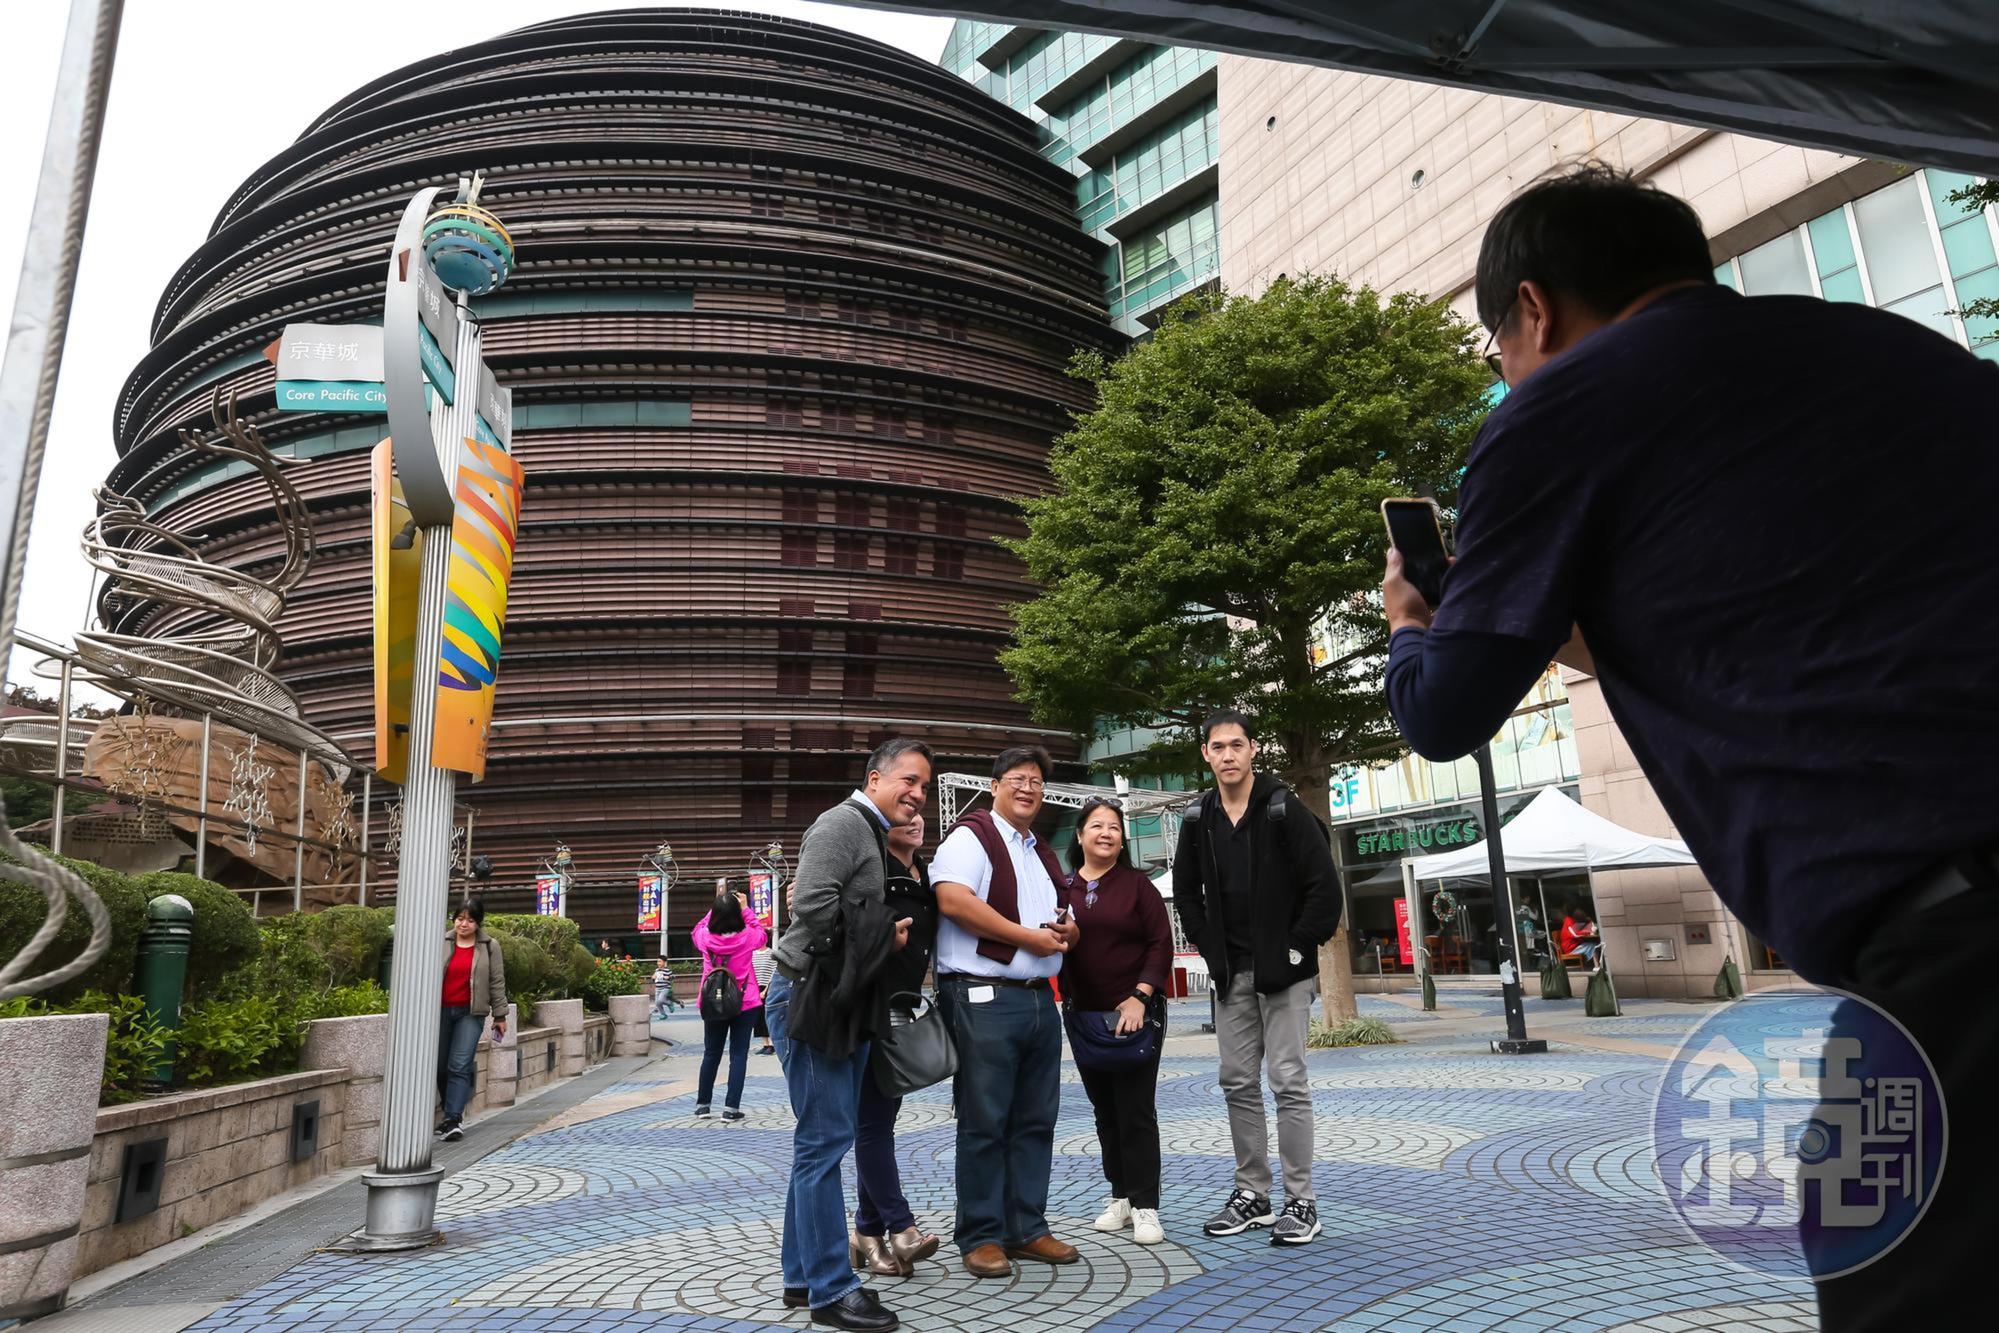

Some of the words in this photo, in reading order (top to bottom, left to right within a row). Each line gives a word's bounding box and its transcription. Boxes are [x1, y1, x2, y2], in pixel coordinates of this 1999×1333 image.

[290, 341, 359, 361] 京華城
[286, 389, 315, 401] Core
[320, 388, 360, 401] Pacific
[364, 390, 387, 404] City
[1332, 780, 1359, 807] 3F
[1357, 820, 1477, 855] STARBUCKS
